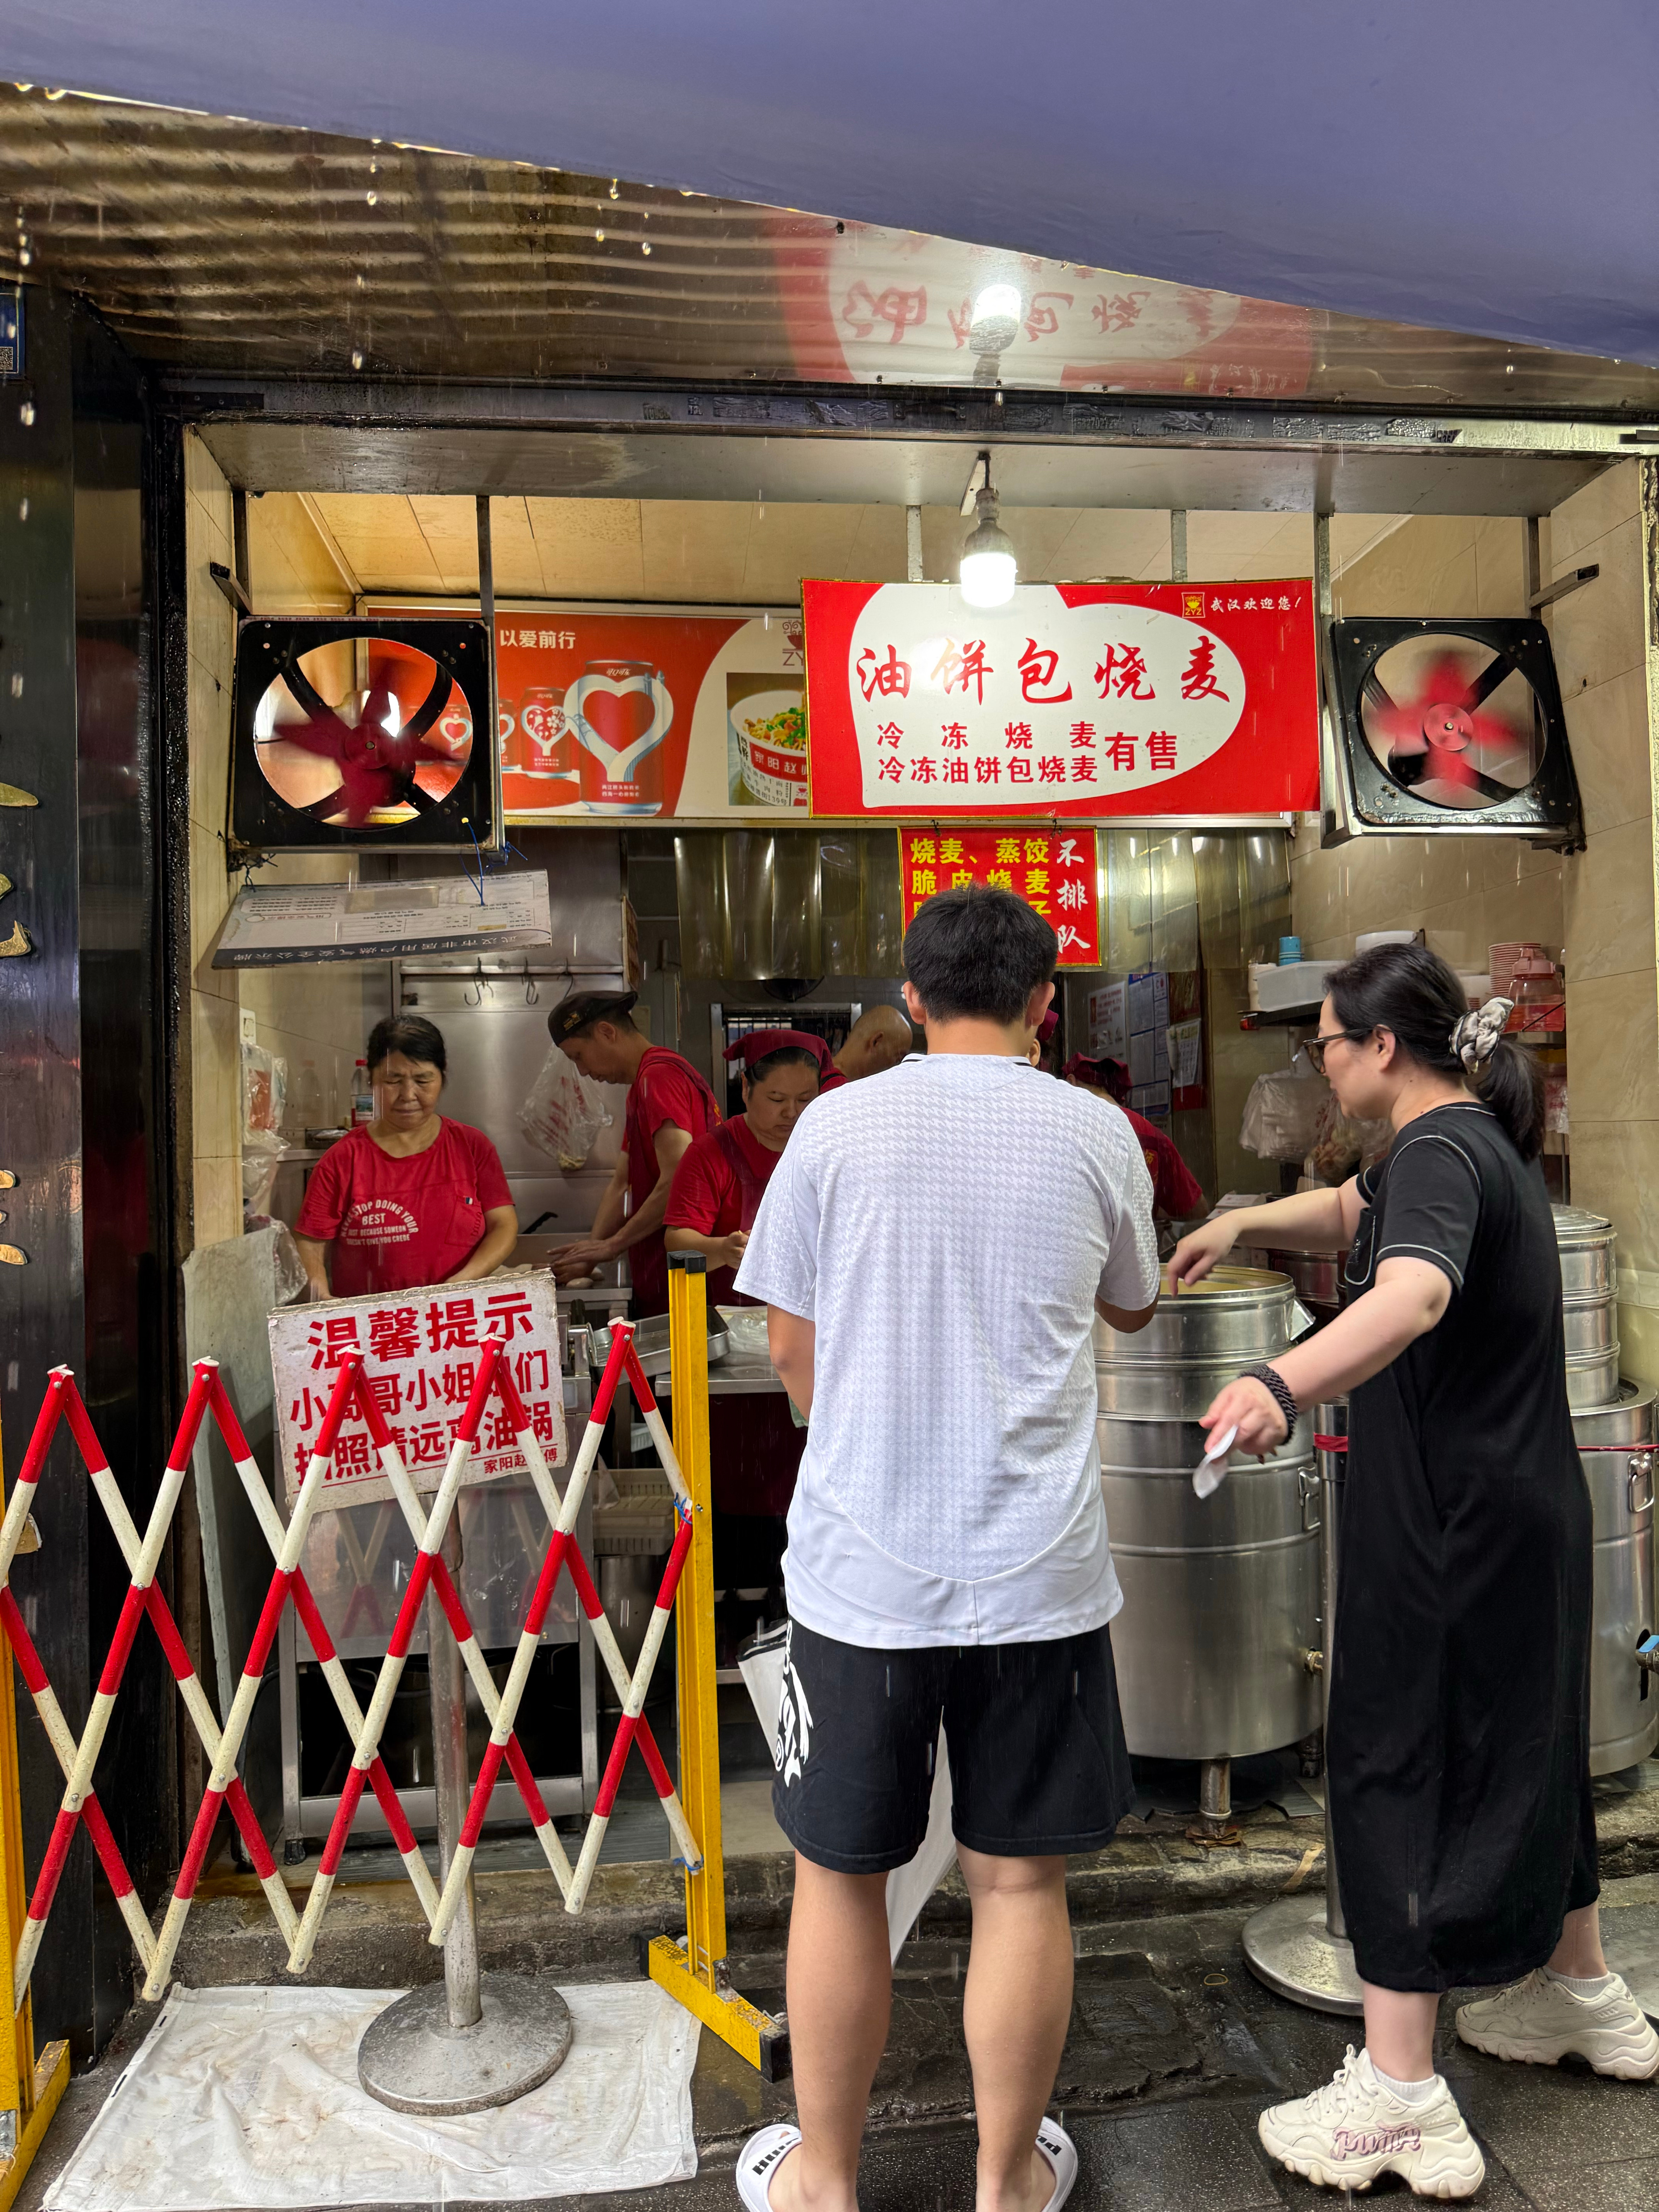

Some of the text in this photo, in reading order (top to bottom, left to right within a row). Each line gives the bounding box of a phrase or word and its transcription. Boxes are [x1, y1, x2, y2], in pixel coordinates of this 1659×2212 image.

[1211, 596, 1301, 613] 武汉欢迎您!
[500, 630, 576, 649] 以爱前行
[856, 635, 1230, 706] 油饼包烧麦
[877, 720, 1097, 750] 冷冻烧麦
[1104, 730, 1178, 772] 有售
[878, 754, 1098, 784] 冷冻油饼包烧麦
[910, 838, 1049, 864] 烧麦、蒸饺
[1056, 838, 1091, 954] 不排队
[352, 1201, 373, 1216] STOP
[375, 1199, 404, 1215] DOING
[401, 1211, 419, 1233] YOUR
[362, 1212, 386, 1226] BEST
[307, 1291, 534, 1370] 温馨提示
[290, 1349, 549, 1431] 小哥小姐们
[484, 1448, 558, 1474] 家阳赵傅
